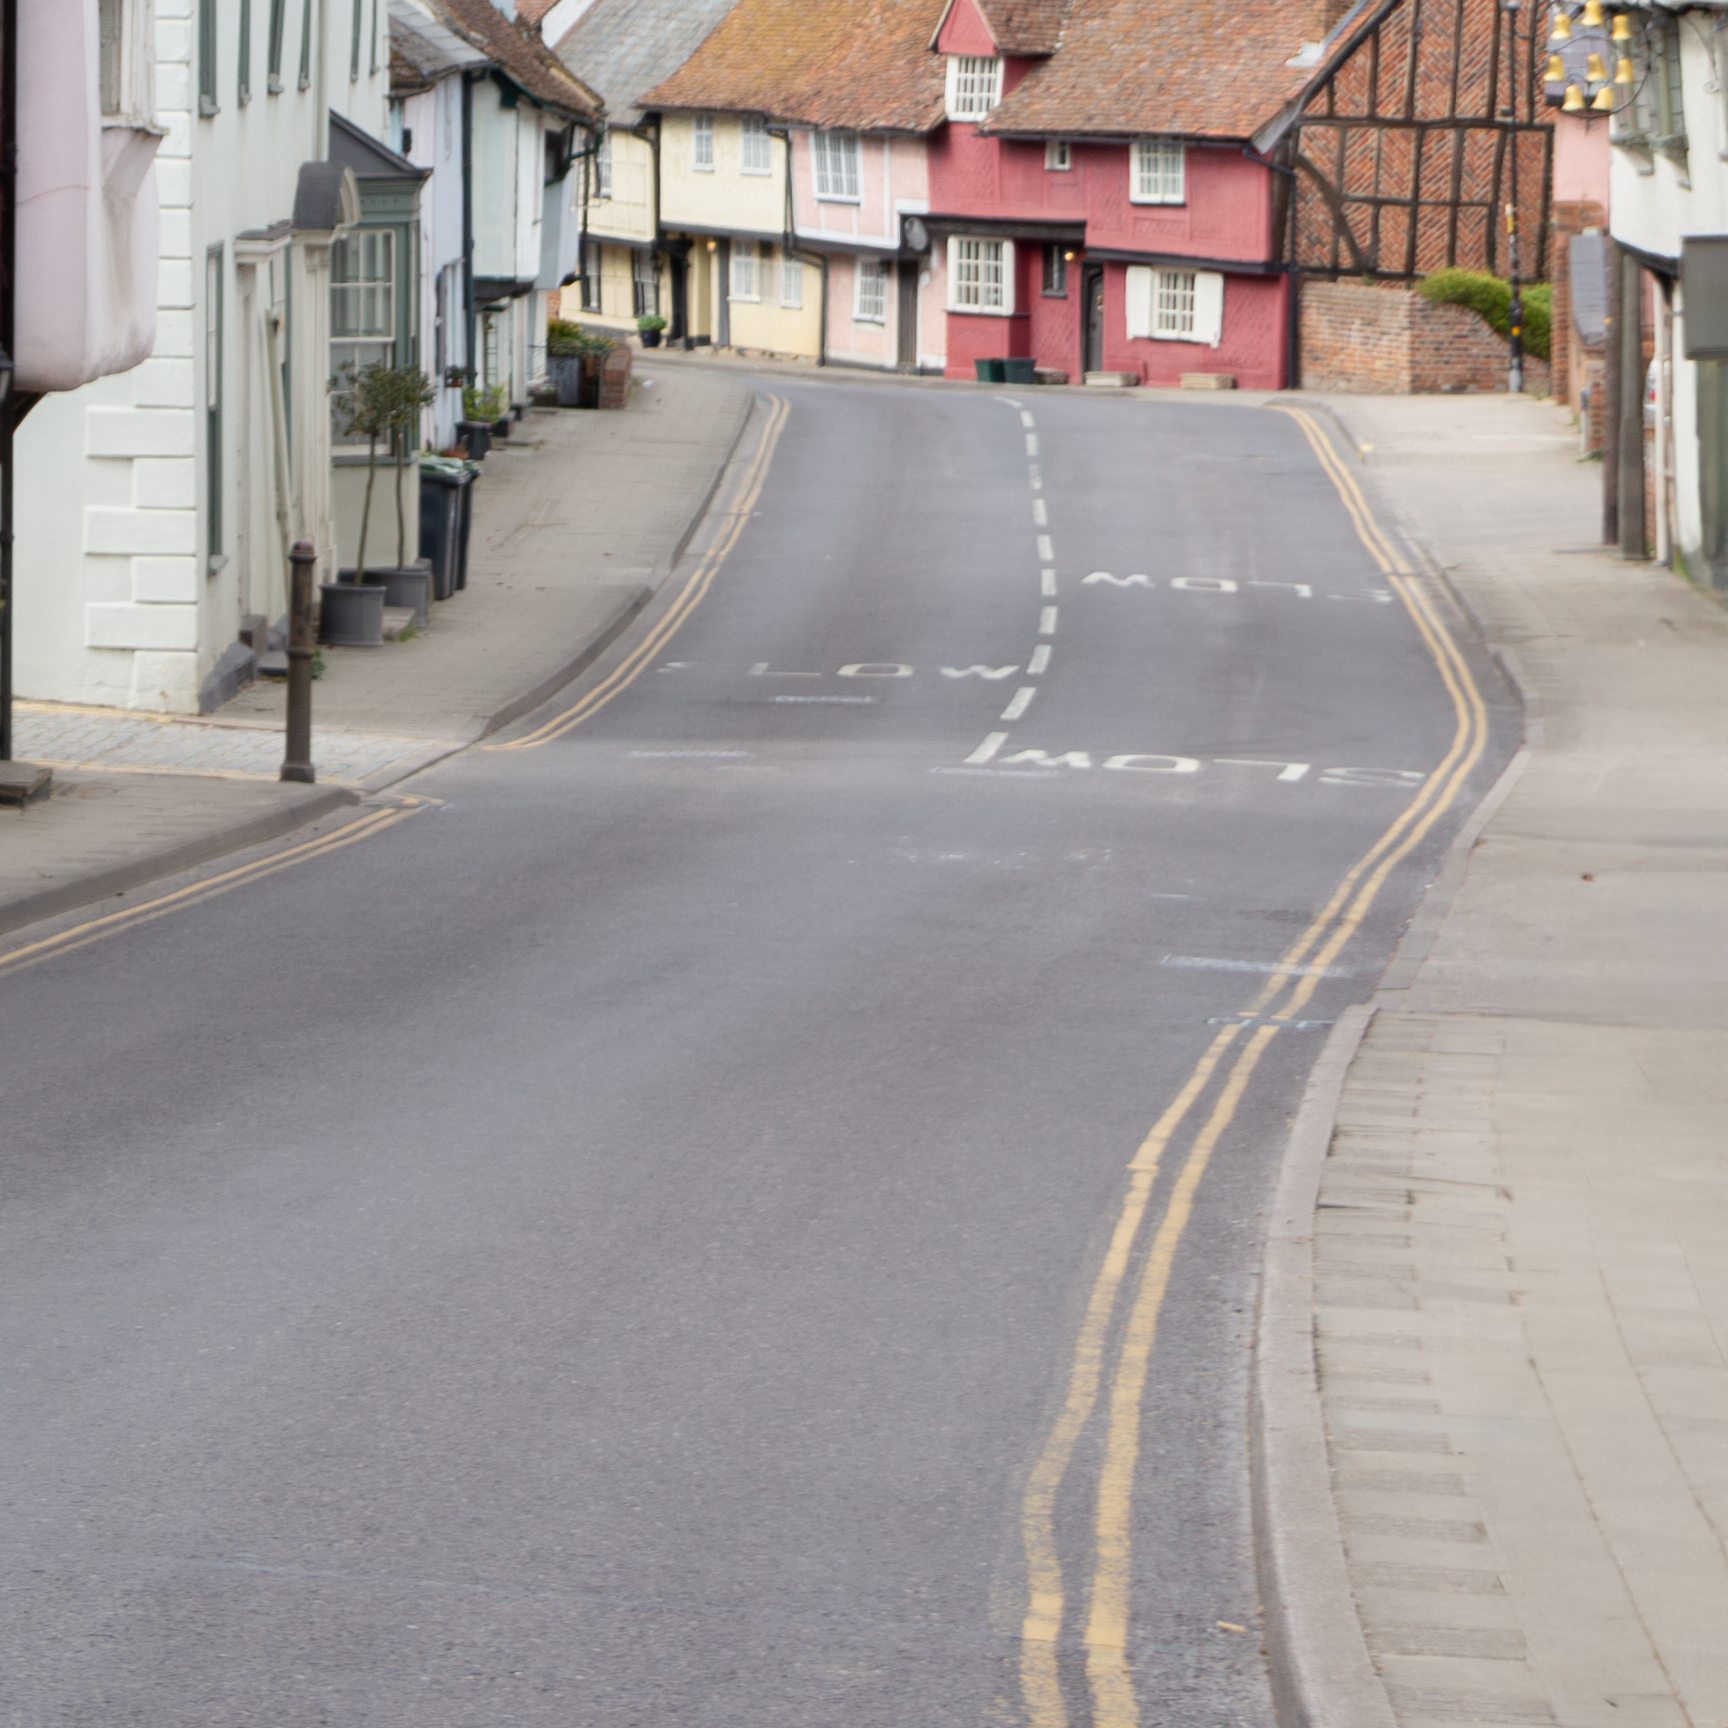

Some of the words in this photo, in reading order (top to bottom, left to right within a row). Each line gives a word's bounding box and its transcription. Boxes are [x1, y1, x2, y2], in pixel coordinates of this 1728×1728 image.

[1081, 571, 1393, 604] SLOW
[655, 660, 1020, 680] SLOW
[1000, 748, 1427, 786] SLOW
